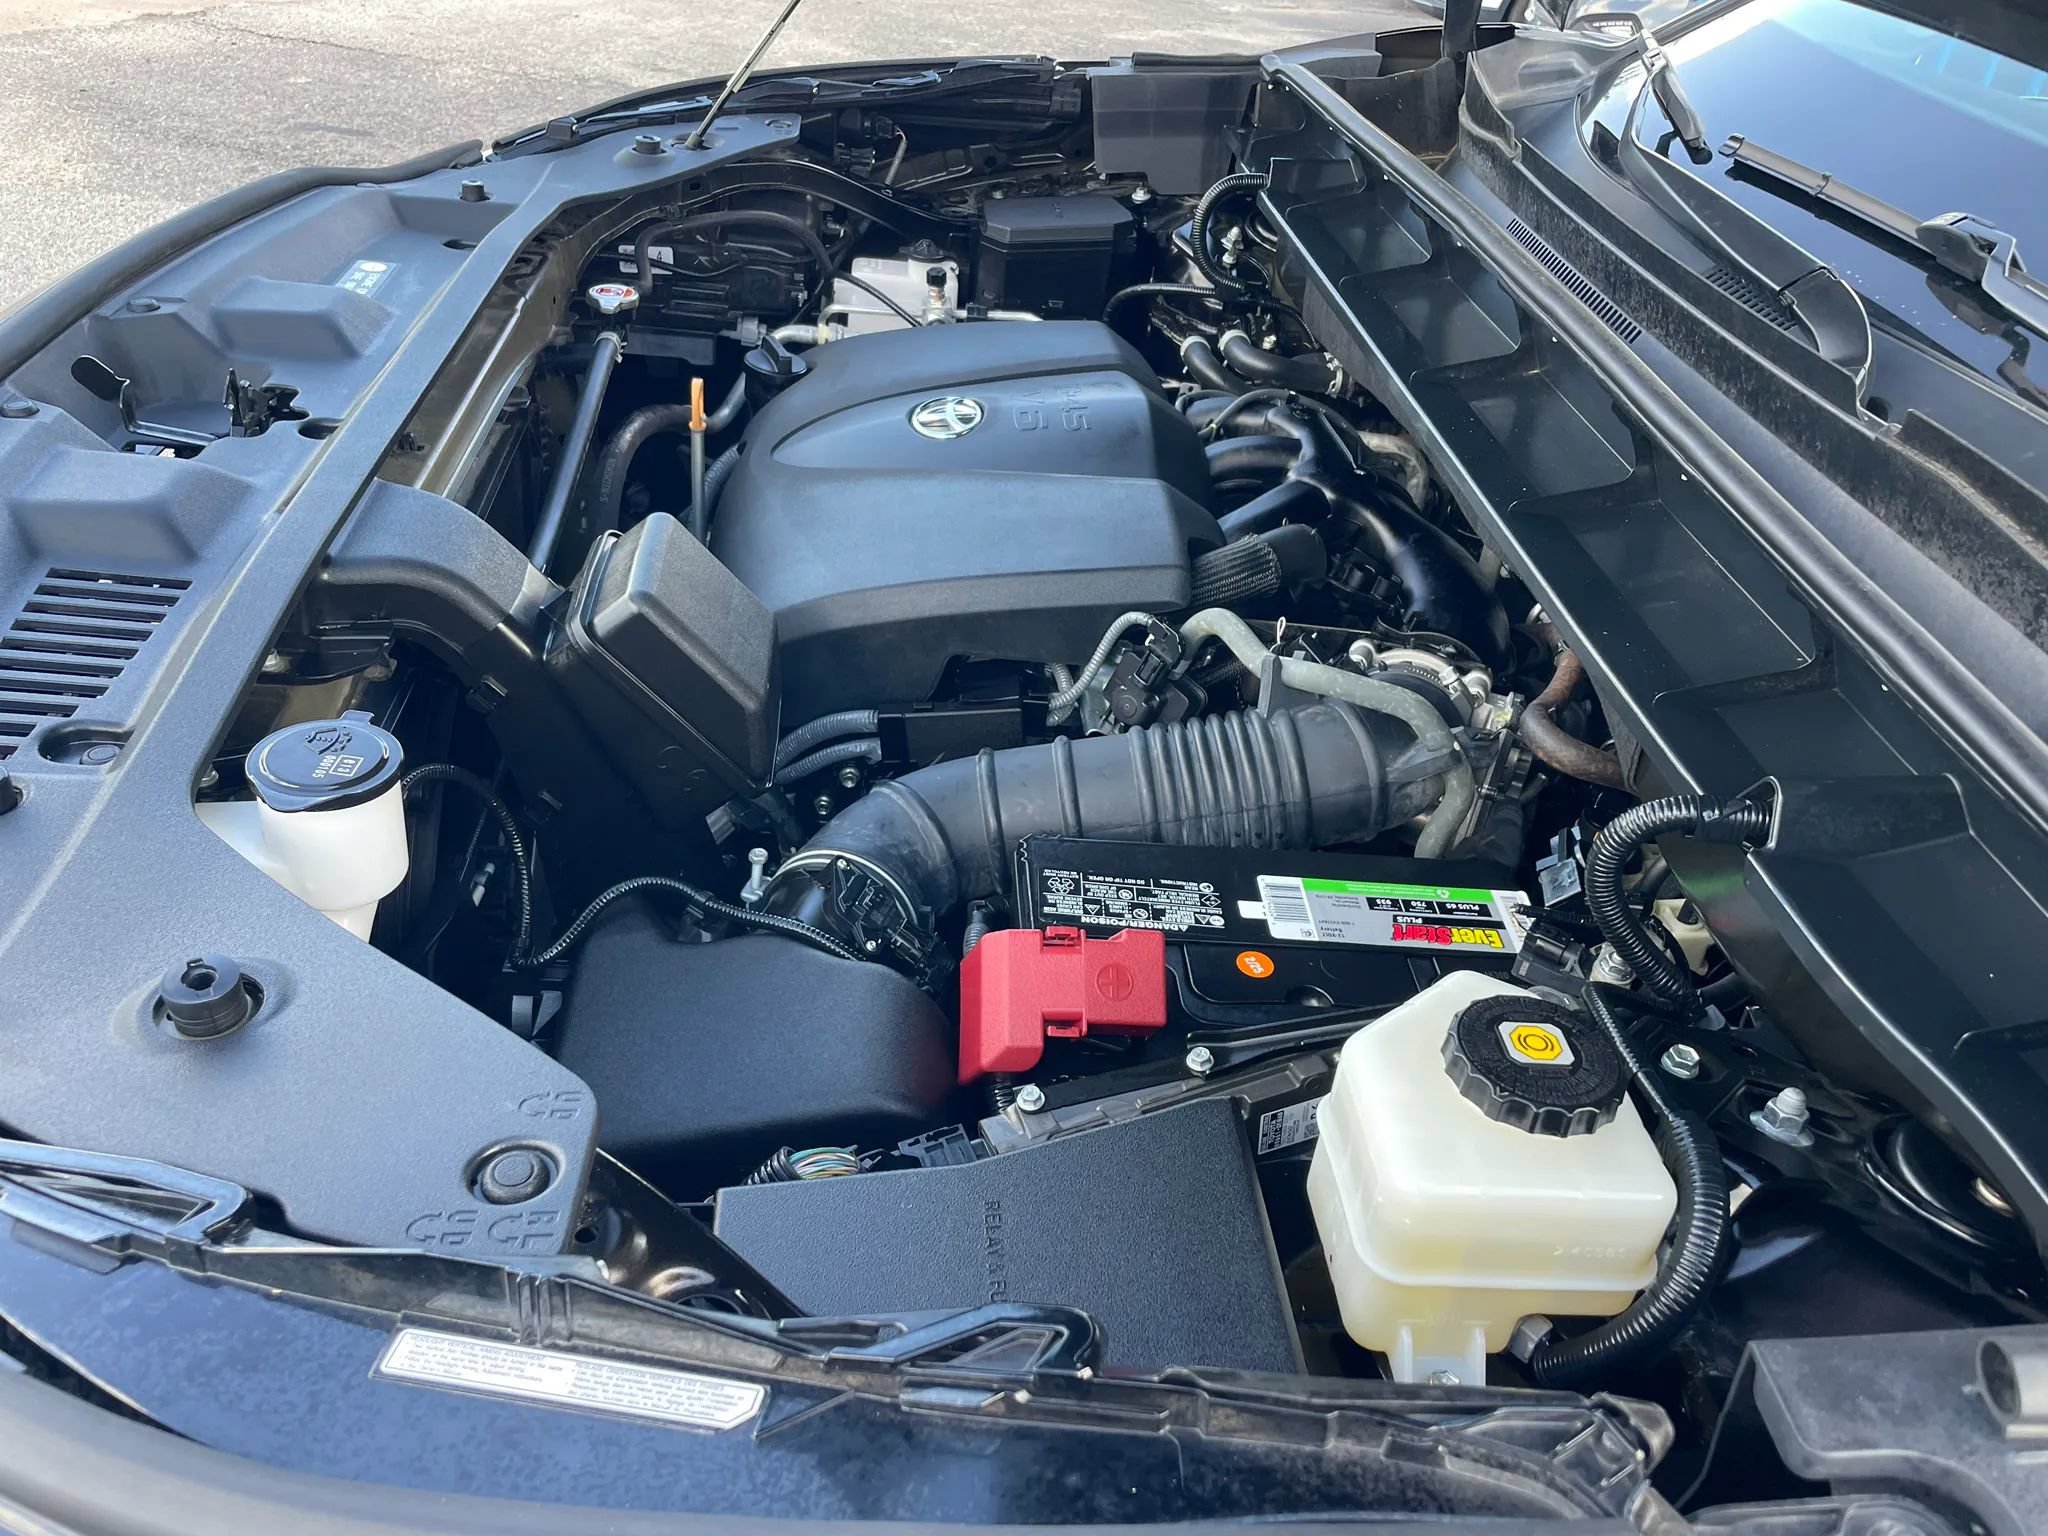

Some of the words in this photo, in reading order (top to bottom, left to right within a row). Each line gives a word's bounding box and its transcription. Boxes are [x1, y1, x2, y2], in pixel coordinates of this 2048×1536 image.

[1012, 391, 1049, 431] V6
[1081, 916, 1179, 930] DANGER/POISON
[1397, 916, 1422, 924] PLUS
[1391, 924, 1504, 949] EverStart
[1243, 956, 1265, 974] 2/25
[984, 1200, 1003, 1256] RELAY
